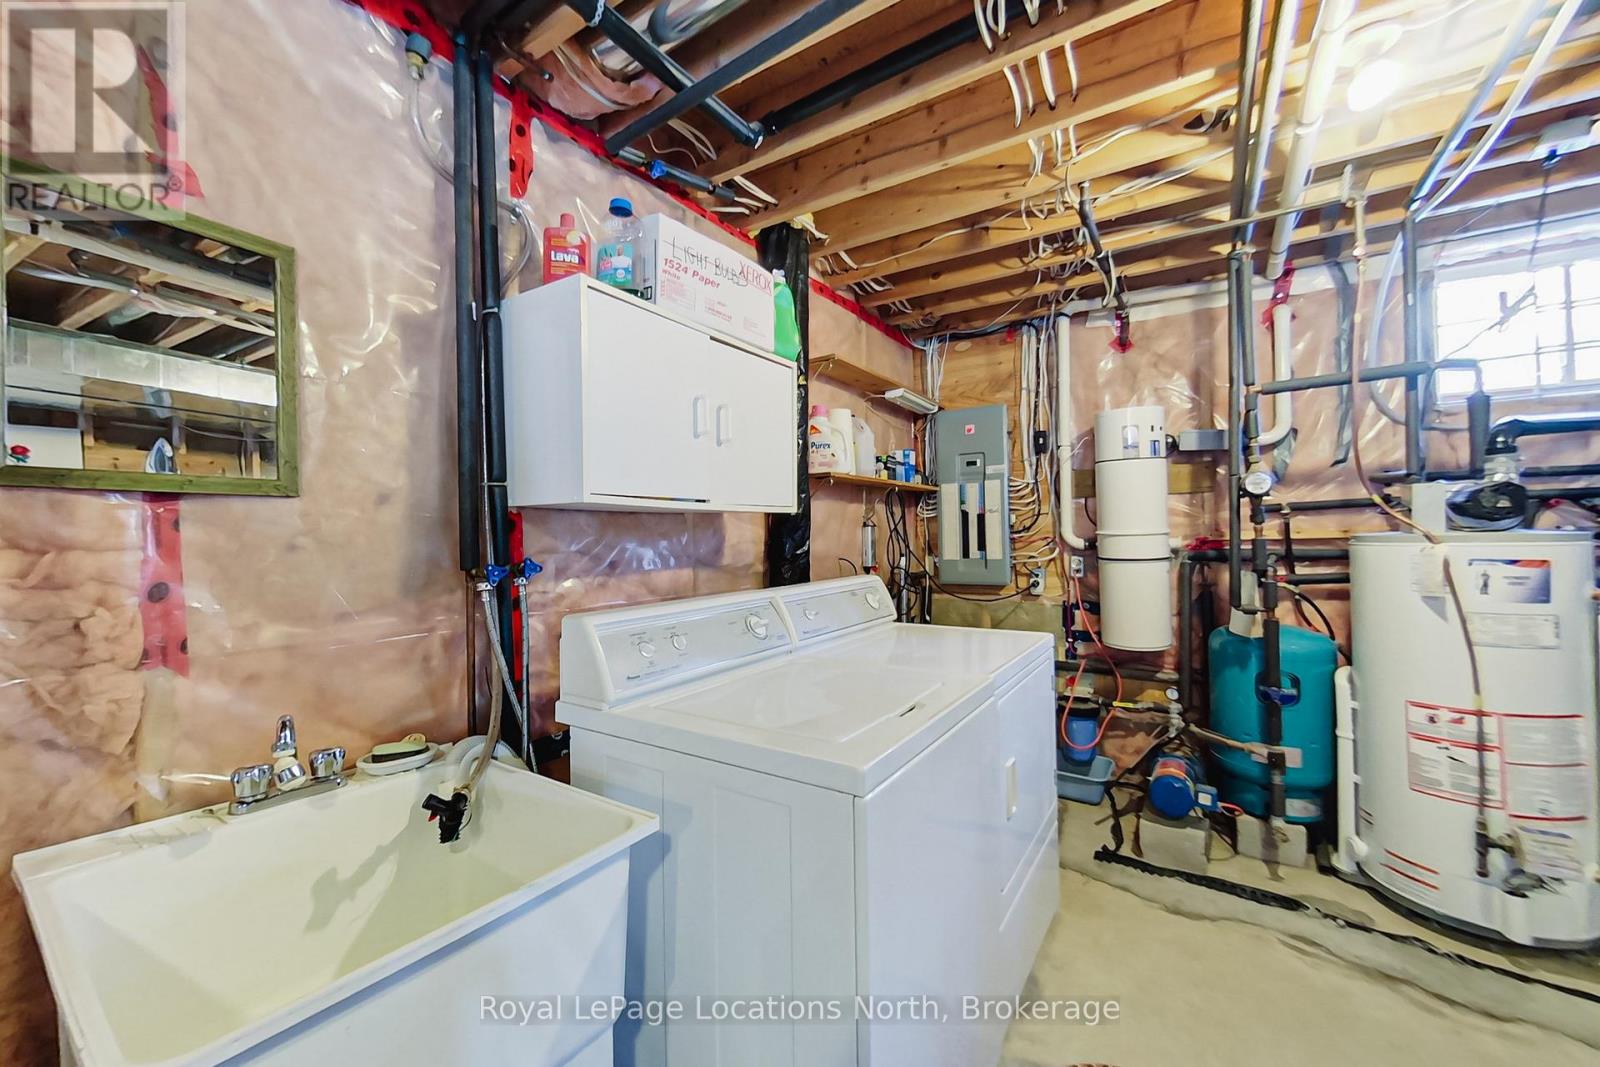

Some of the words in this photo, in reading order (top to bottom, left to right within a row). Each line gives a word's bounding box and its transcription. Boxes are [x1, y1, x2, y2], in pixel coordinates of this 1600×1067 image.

[551, 250, 580, 264] Lava
[671, 237, 709, 270] LIGHT
[663, 258, 689, 275] 1524
[692, 269, 721, 289] Paper
[739, 260, 773, 296] XEROX
[810, 441, 831, 450] Purex
